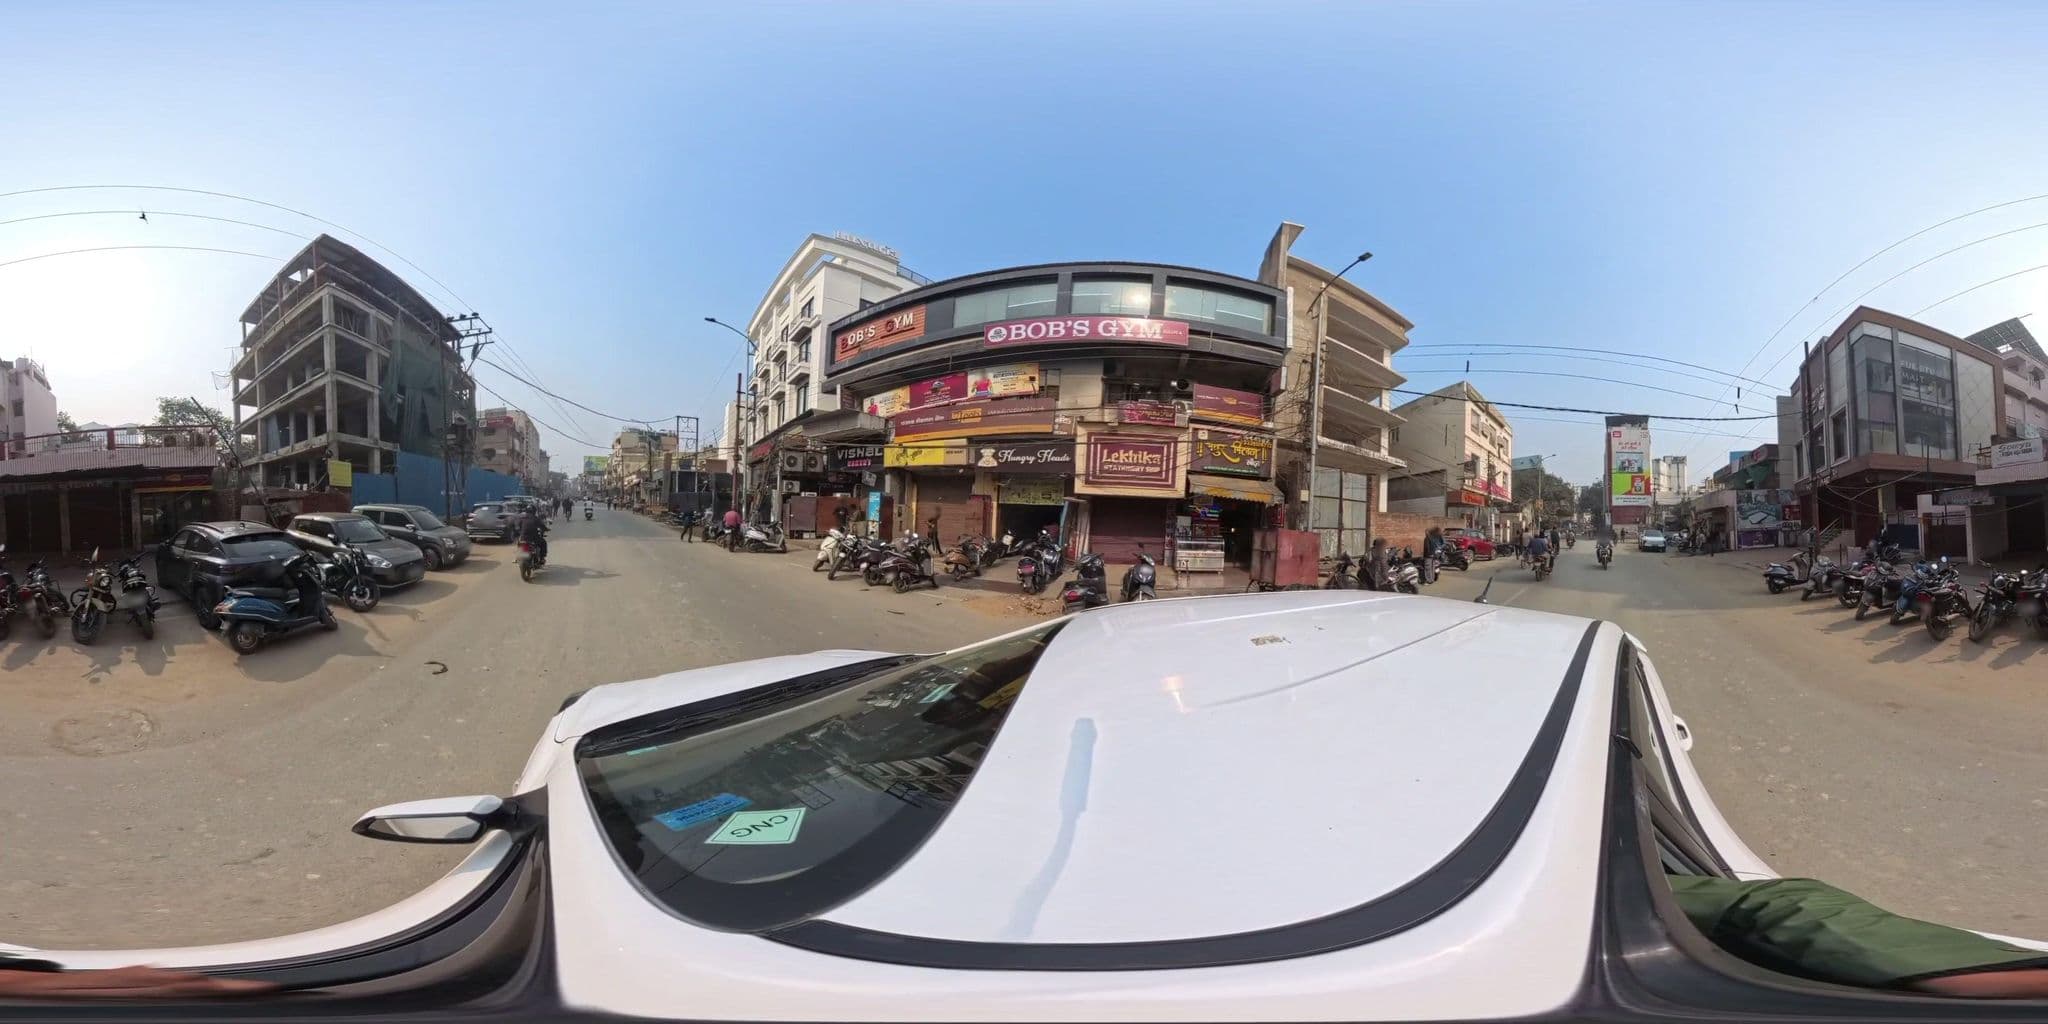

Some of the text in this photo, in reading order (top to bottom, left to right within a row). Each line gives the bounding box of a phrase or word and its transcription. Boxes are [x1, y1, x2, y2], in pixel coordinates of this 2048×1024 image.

[1008, 319, 1090, 341] BOB'S
[1097, 319, 1163, 340] GYM
[998, 448, 1071, 464] Hungry Heads
[1101, 448, 1161, 464] Lekhika
[730, 815, 788, 838] CNG
